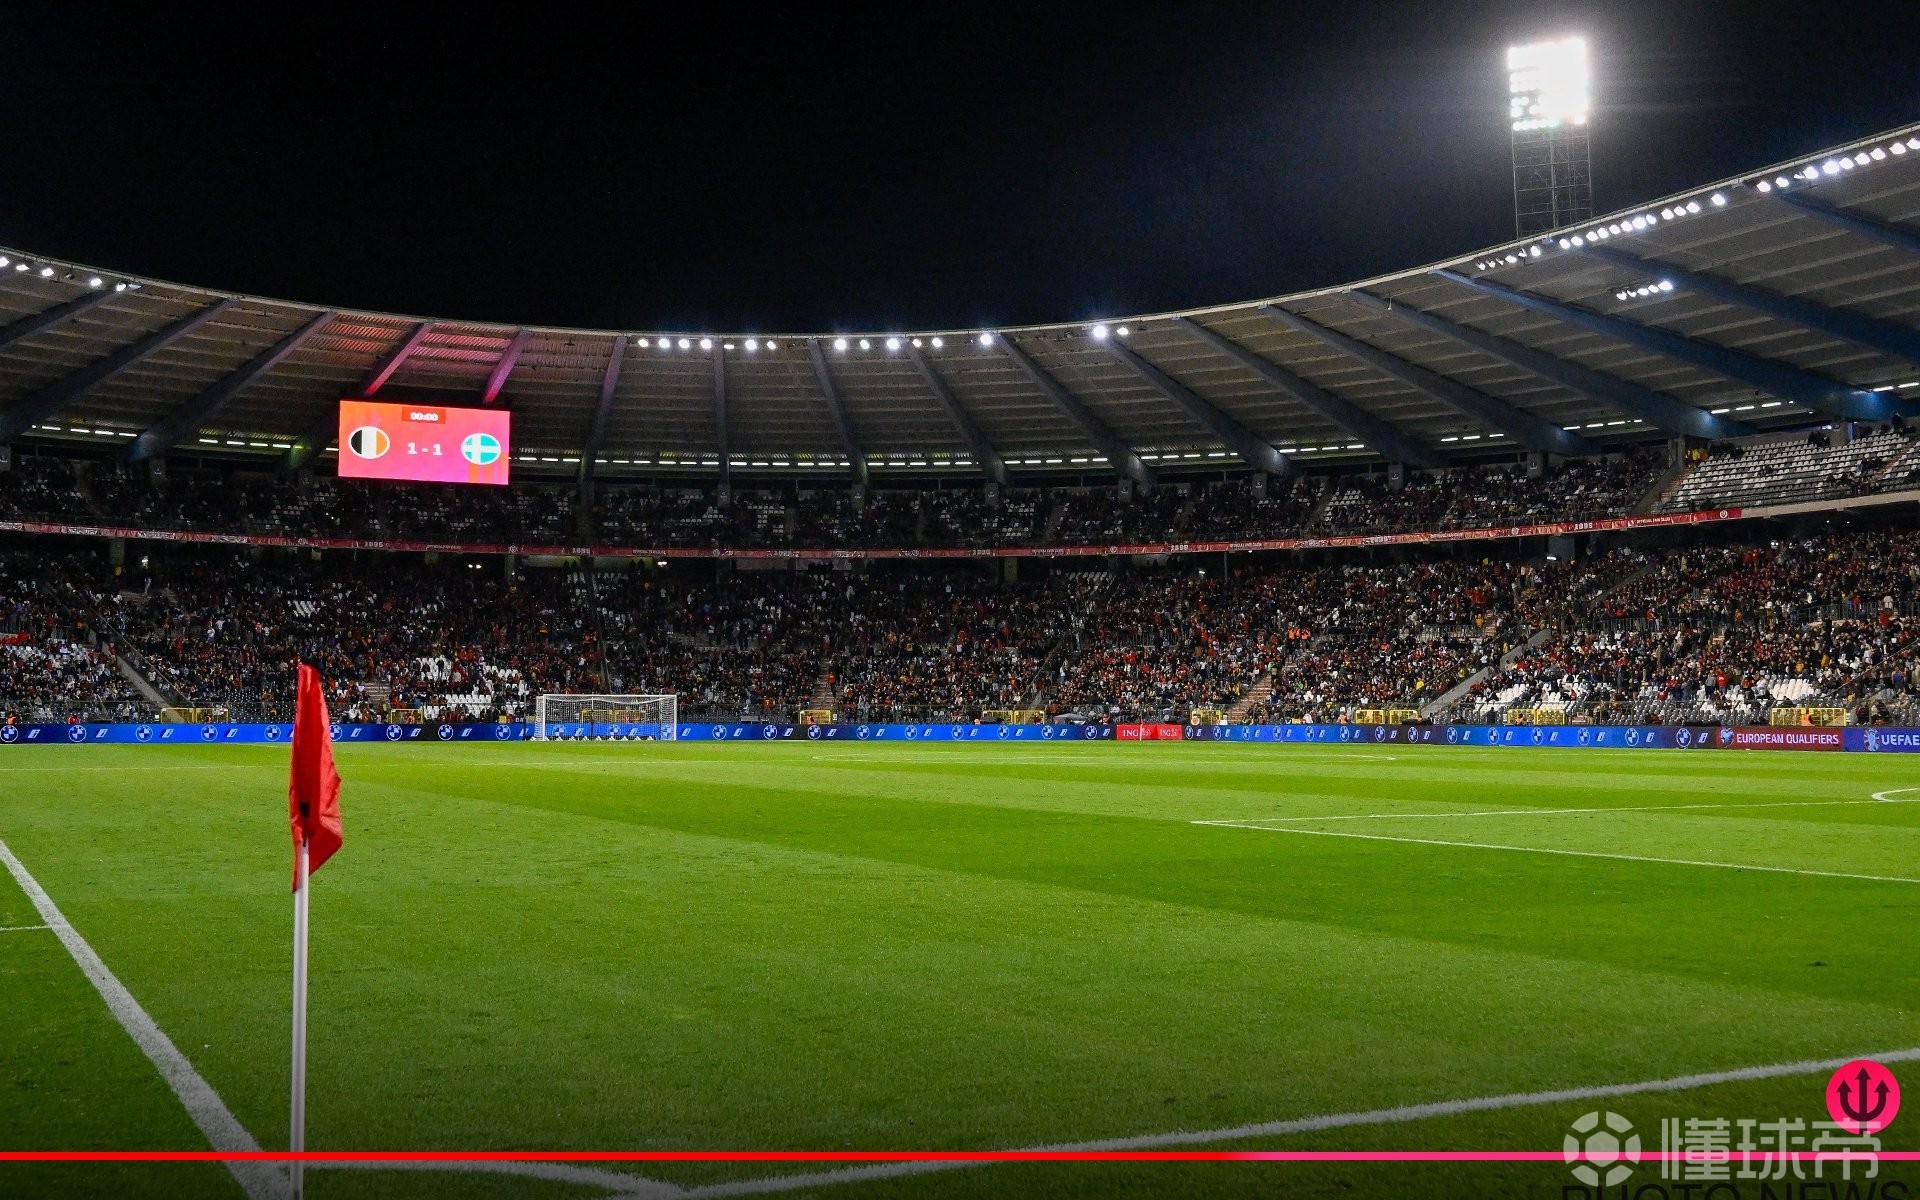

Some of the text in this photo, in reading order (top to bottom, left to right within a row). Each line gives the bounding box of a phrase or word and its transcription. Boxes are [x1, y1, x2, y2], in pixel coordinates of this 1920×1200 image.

[410, 412, 438, 421] 00:00
[408, 442, 418, 455] 1
[432, 443, 443, 456] 1
[1123, 729, 1139, 737] ING
[1160, 729, 1171, 737] ING
[1736, 733, 1839, 744] EUROPEAN QUALIFIERS
